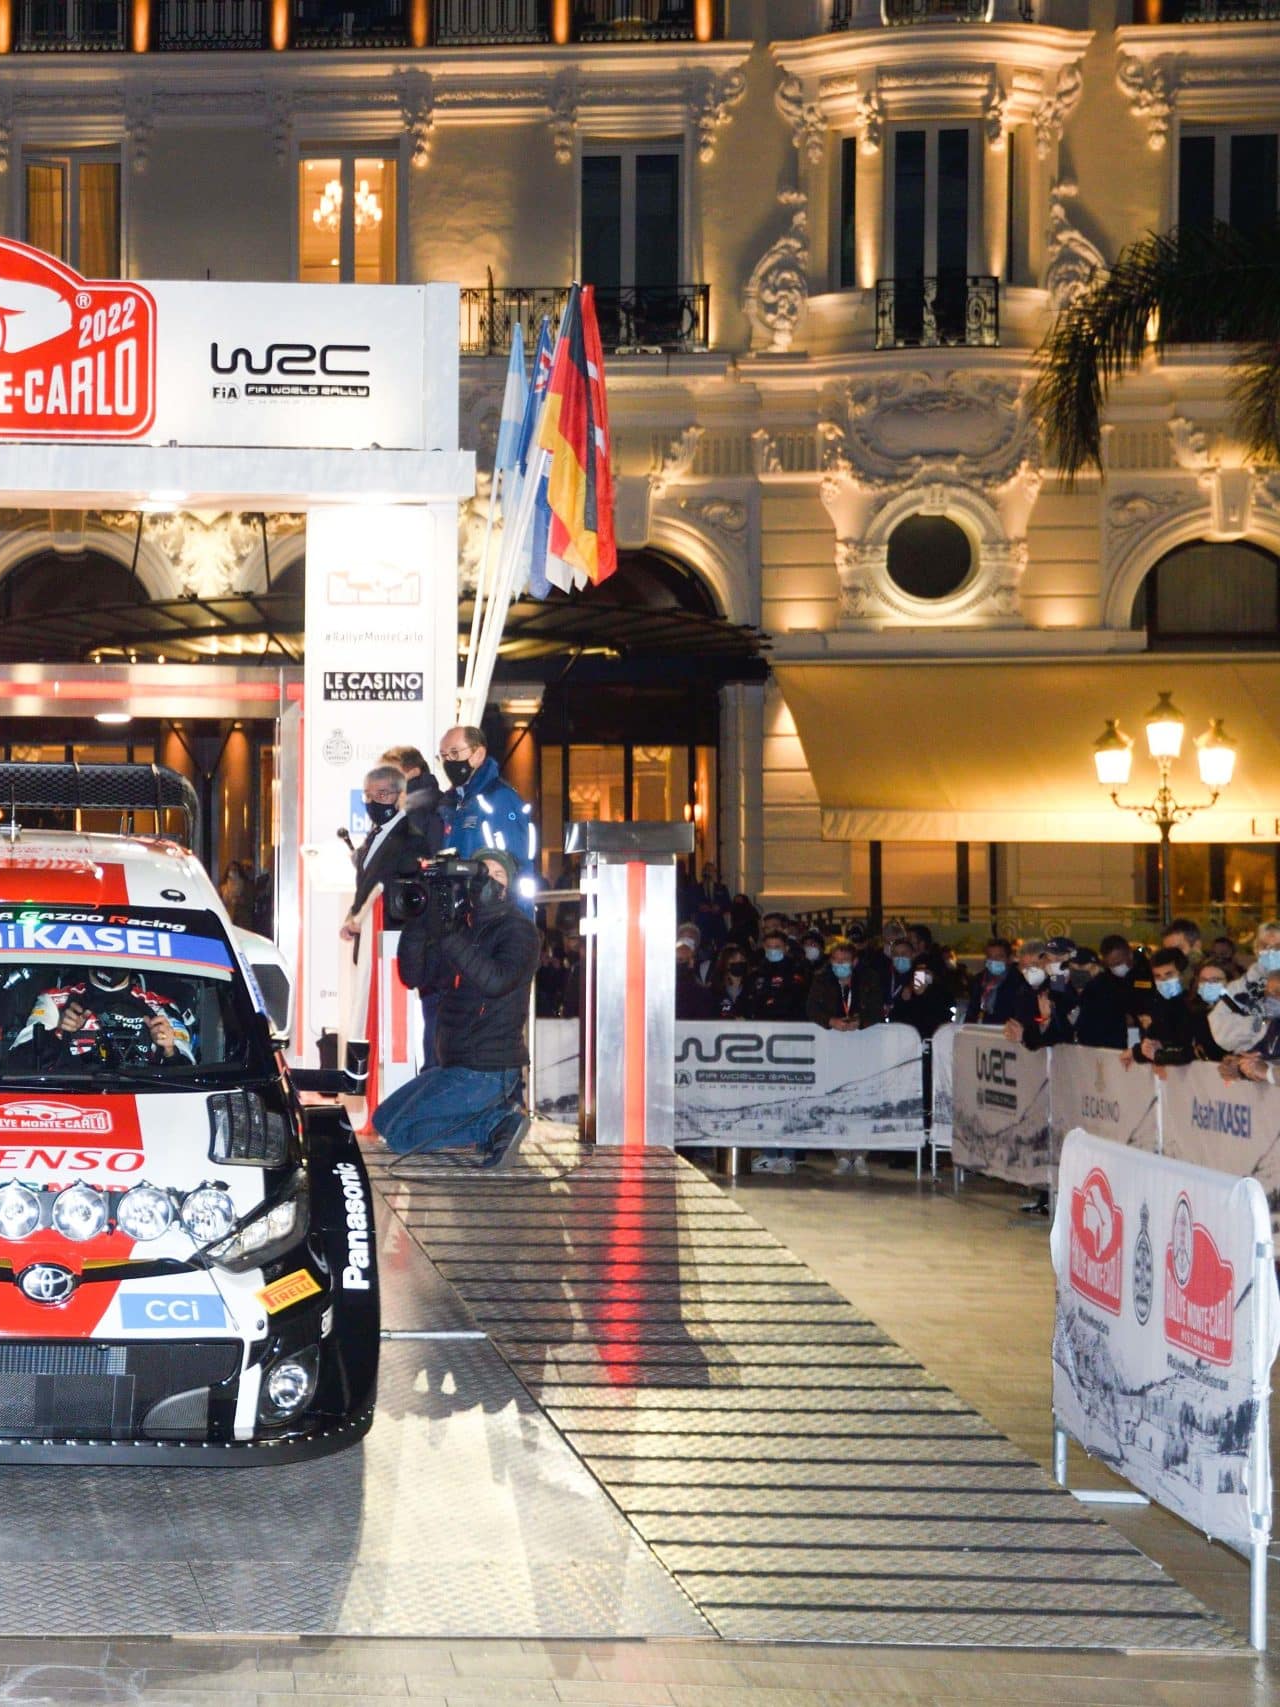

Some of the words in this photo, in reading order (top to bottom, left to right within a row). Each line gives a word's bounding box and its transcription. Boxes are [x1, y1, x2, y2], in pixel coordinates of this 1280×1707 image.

[78, 296, 136, 349] 2022
[210, 341, 371, 376] WRC
[324, 673, 345, 690] LE
[347, 672, 422, 690] CASINO
[19, 910, 105, 923] GAZOO
[108, 914, 187, 933] Racing
[332, 1162, 371, 1290] Panasonic
[261, 1273, 315, 1309] PIRELLI
